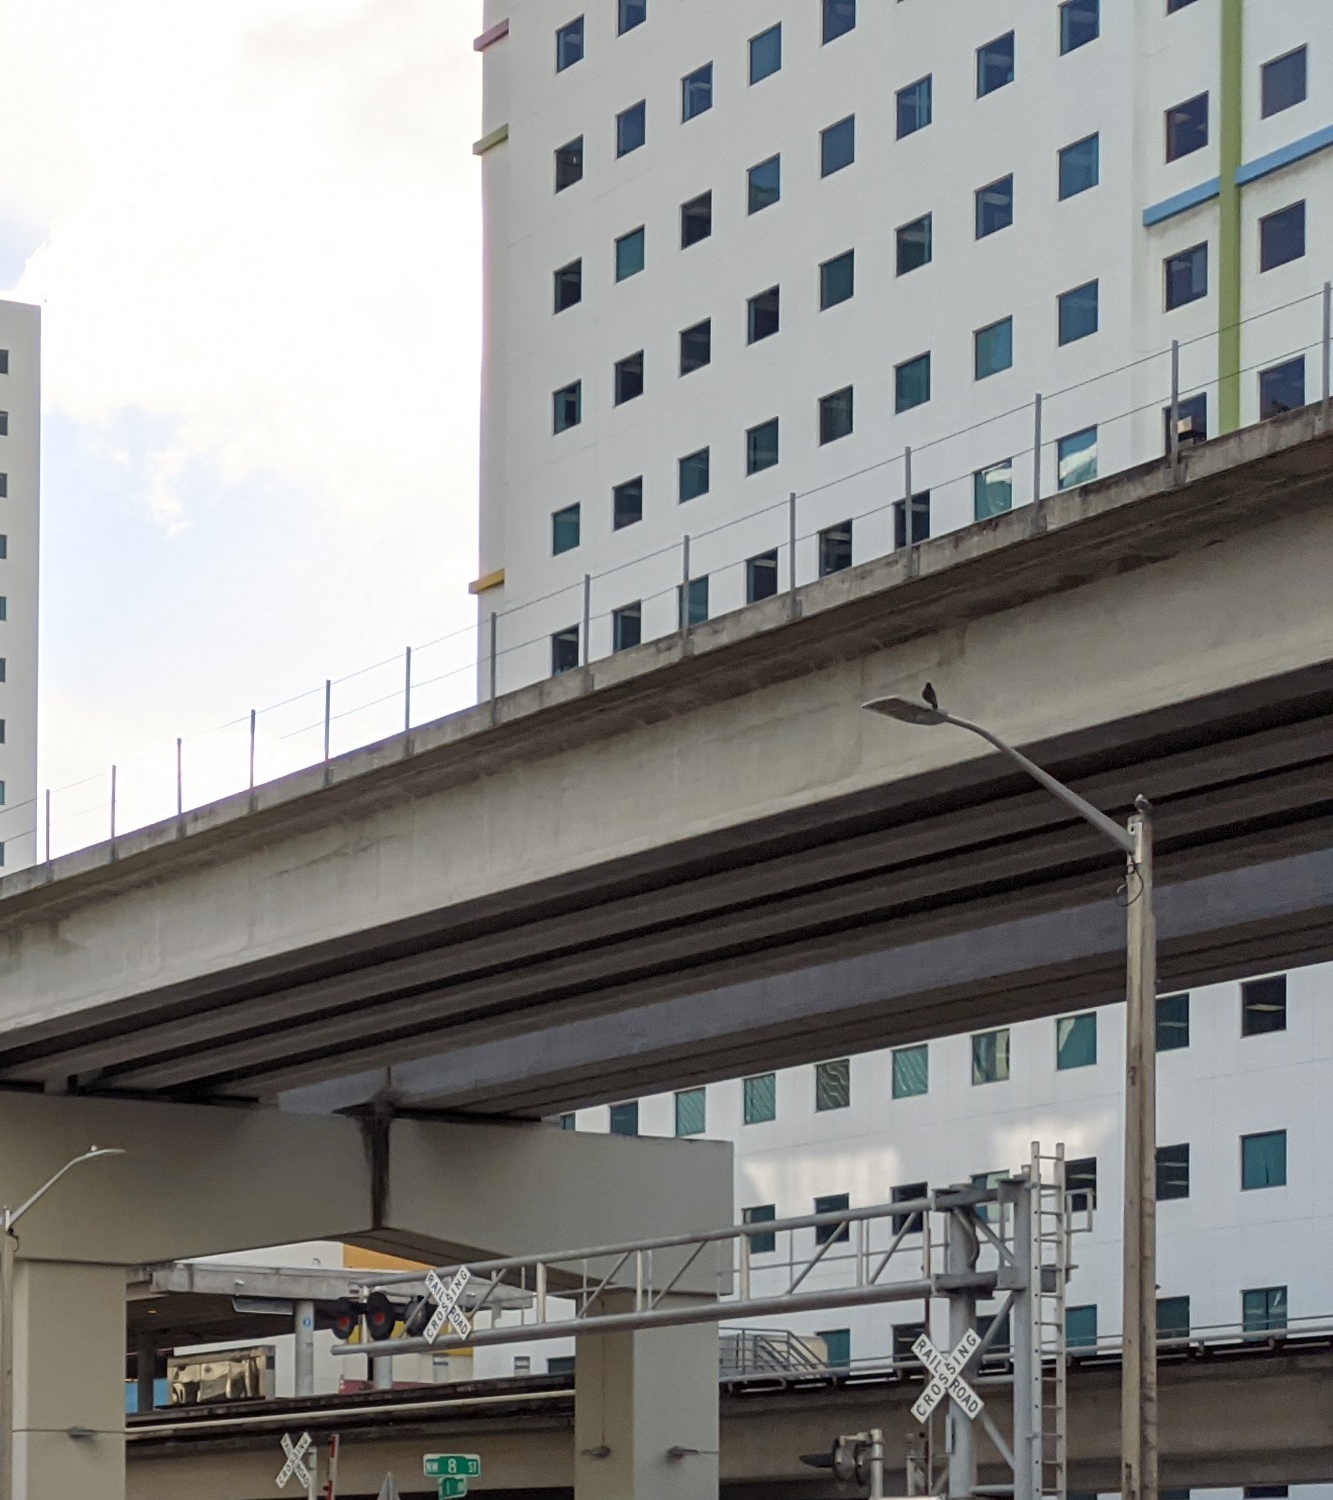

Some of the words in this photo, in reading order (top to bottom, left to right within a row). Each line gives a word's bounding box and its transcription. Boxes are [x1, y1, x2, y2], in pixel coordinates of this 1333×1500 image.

[426, 1270, 467, 1338] CROSSING
[915, 1338, 942, 1373] RAIL
[949, 1379, 978, 1413] ROAD
[916, 1333, 977, 1417] CROSSING
[278, 1438, 308, 1484] CROSSING
[447, 1458, 457, 1473] 8
